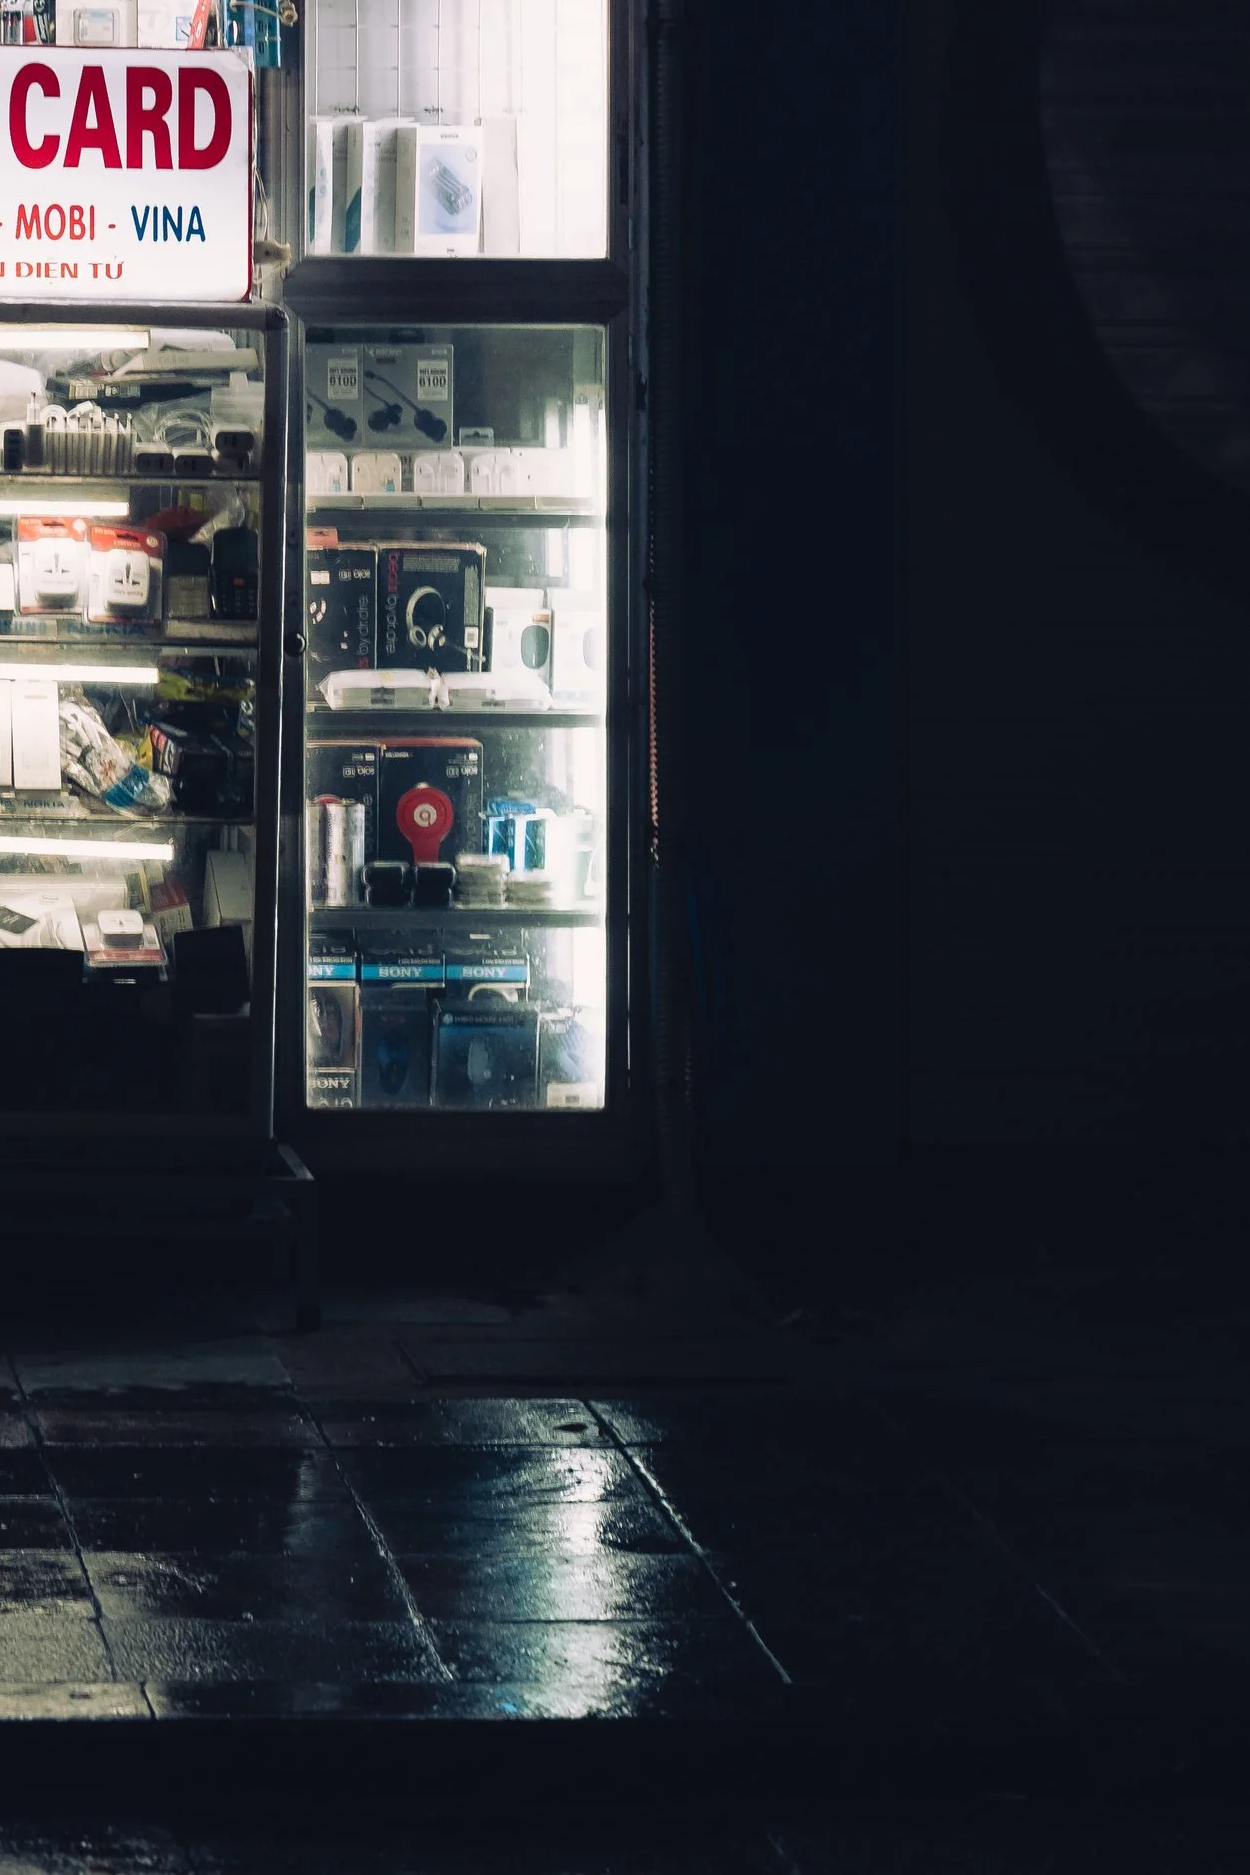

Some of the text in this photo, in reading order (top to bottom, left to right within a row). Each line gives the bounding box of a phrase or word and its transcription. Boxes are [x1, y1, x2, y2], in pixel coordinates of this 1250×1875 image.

[9, 62, 233, 171] CARD
[15, 203, 95, 241] MOBI
[131, 205, 207, 243] VINA
[23, 800, 65, 809] NOKIA
[378, 965, 423, 978] SONY
[461, 965, 507, 978] SONY
